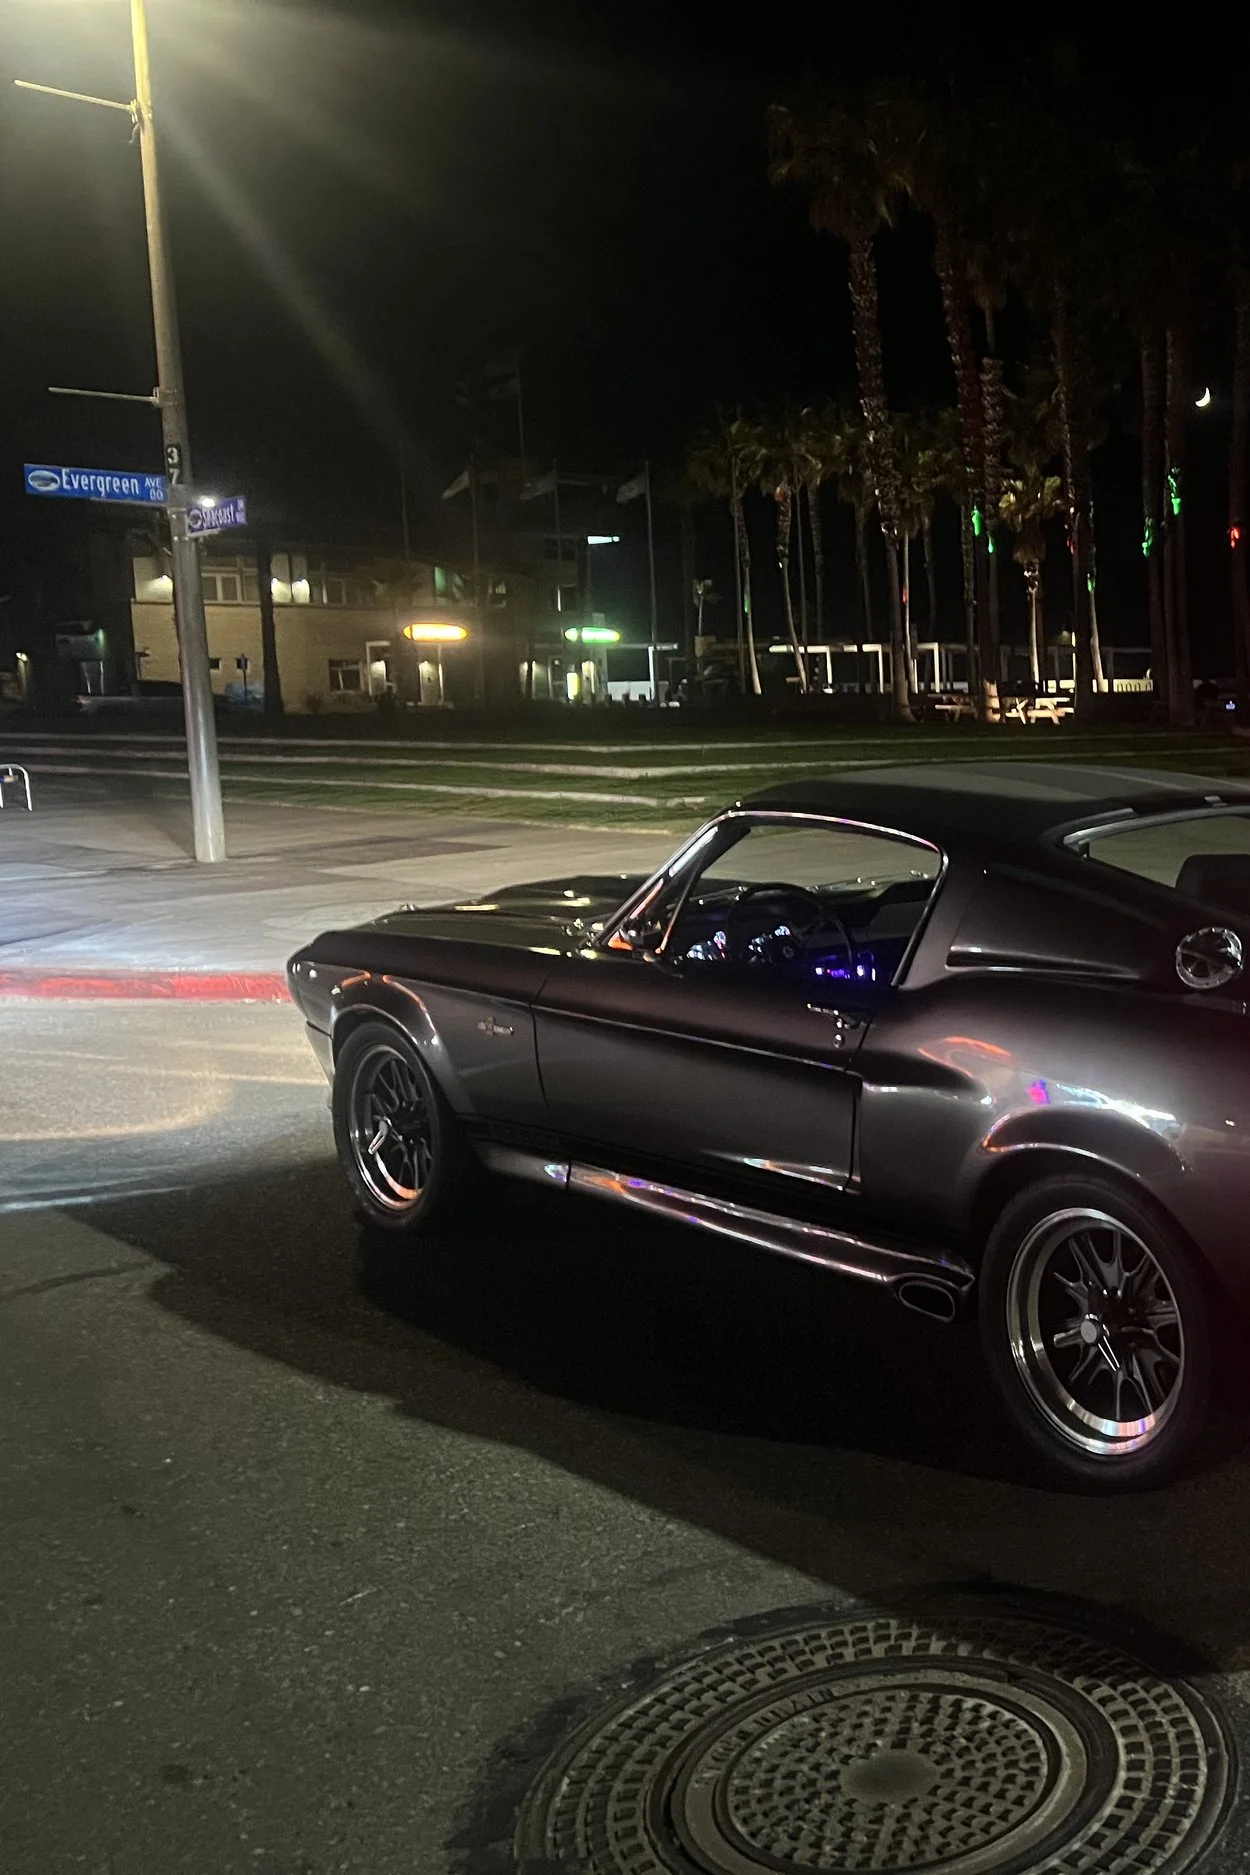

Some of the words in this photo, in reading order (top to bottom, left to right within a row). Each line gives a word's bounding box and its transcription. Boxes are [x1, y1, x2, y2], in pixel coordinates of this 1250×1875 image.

[166, 447, 179, 464] 3
[62, 469, 139, 497] Evergreen
[145, 477, 162, 489] AVE
[753, 1688, 836, 1727] DRAIN
